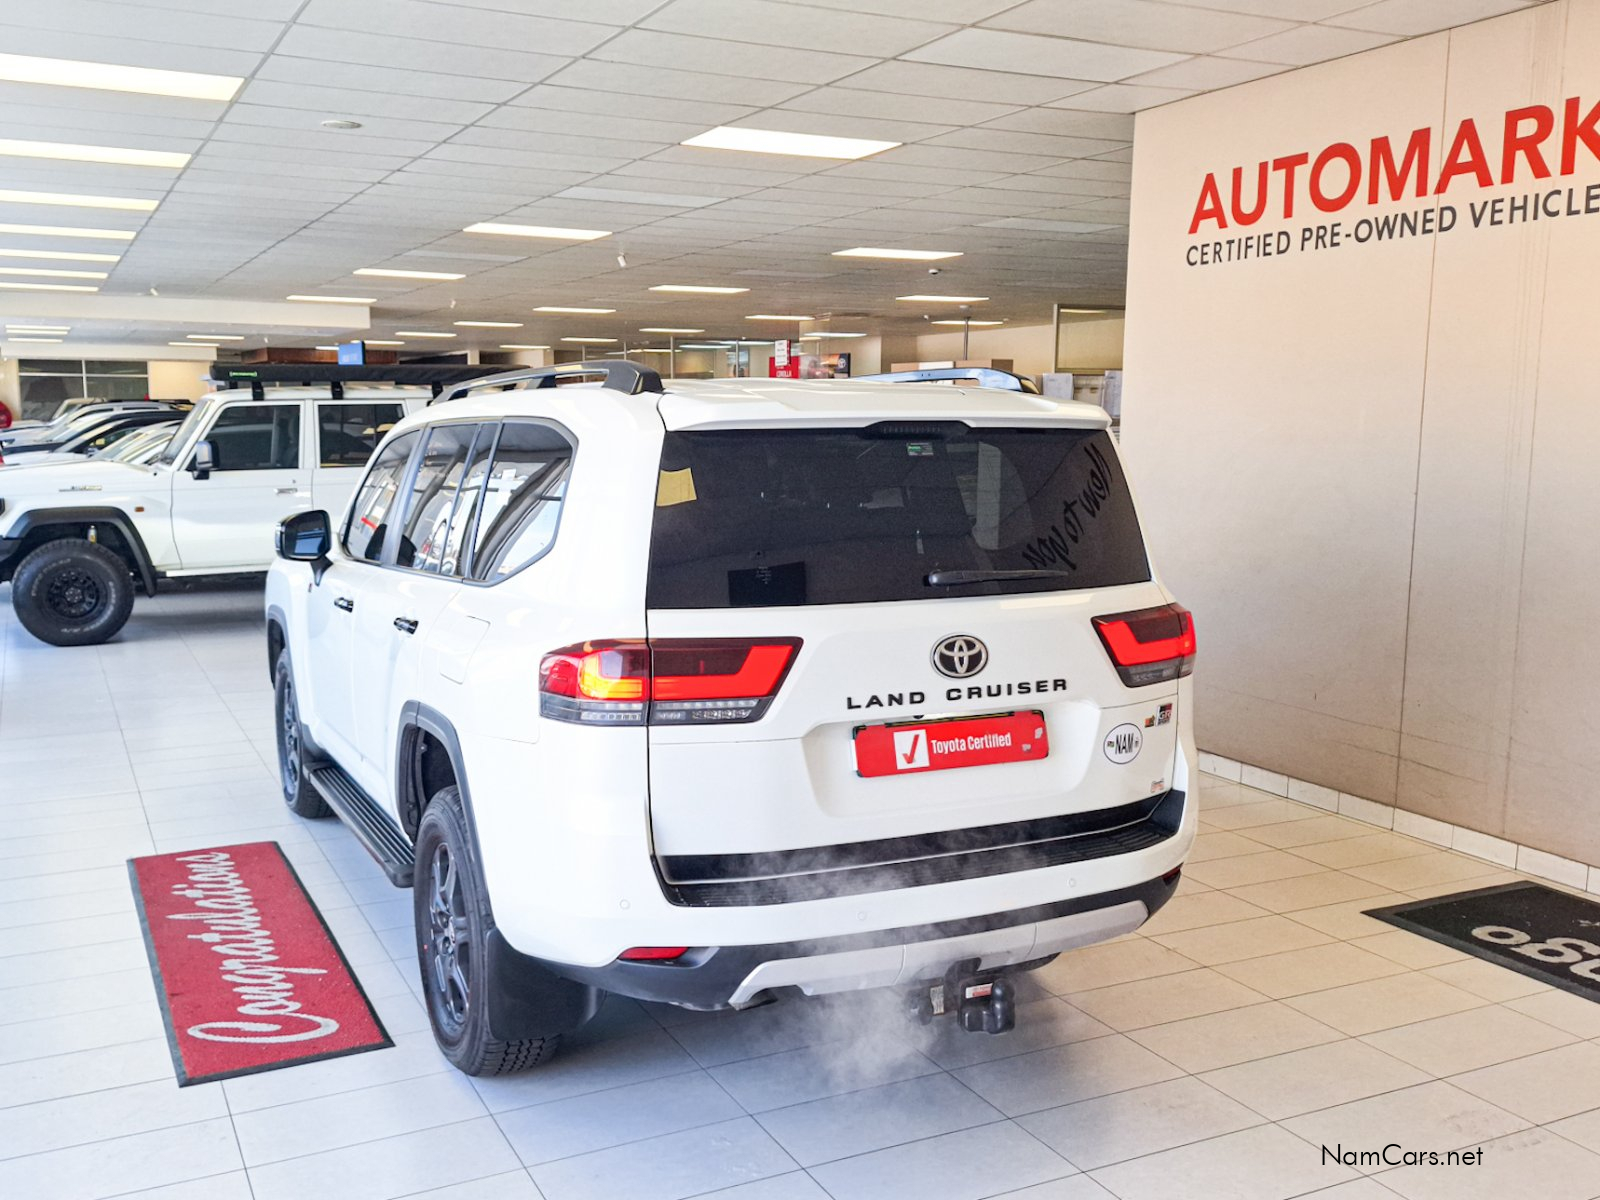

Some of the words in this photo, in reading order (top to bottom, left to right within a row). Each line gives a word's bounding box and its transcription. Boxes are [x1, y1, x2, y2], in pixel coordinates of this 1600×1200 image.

[1188, 96, 1600, 234] AUTOMARK
[1186, 230, 1291, 267] CERTIFIED
[1300, 205, 1457, 252] PRE-OWNED
[847, 691, 925, 710] LAND
[945, 678, 1068, 702] CRUISER
[931, 737, 967, 755] Toyota
[967, 731, 1012, 751] Certified
[1115, 733, 1134, 755] NAM
[166, 851, 340, 1044] Congratulations
